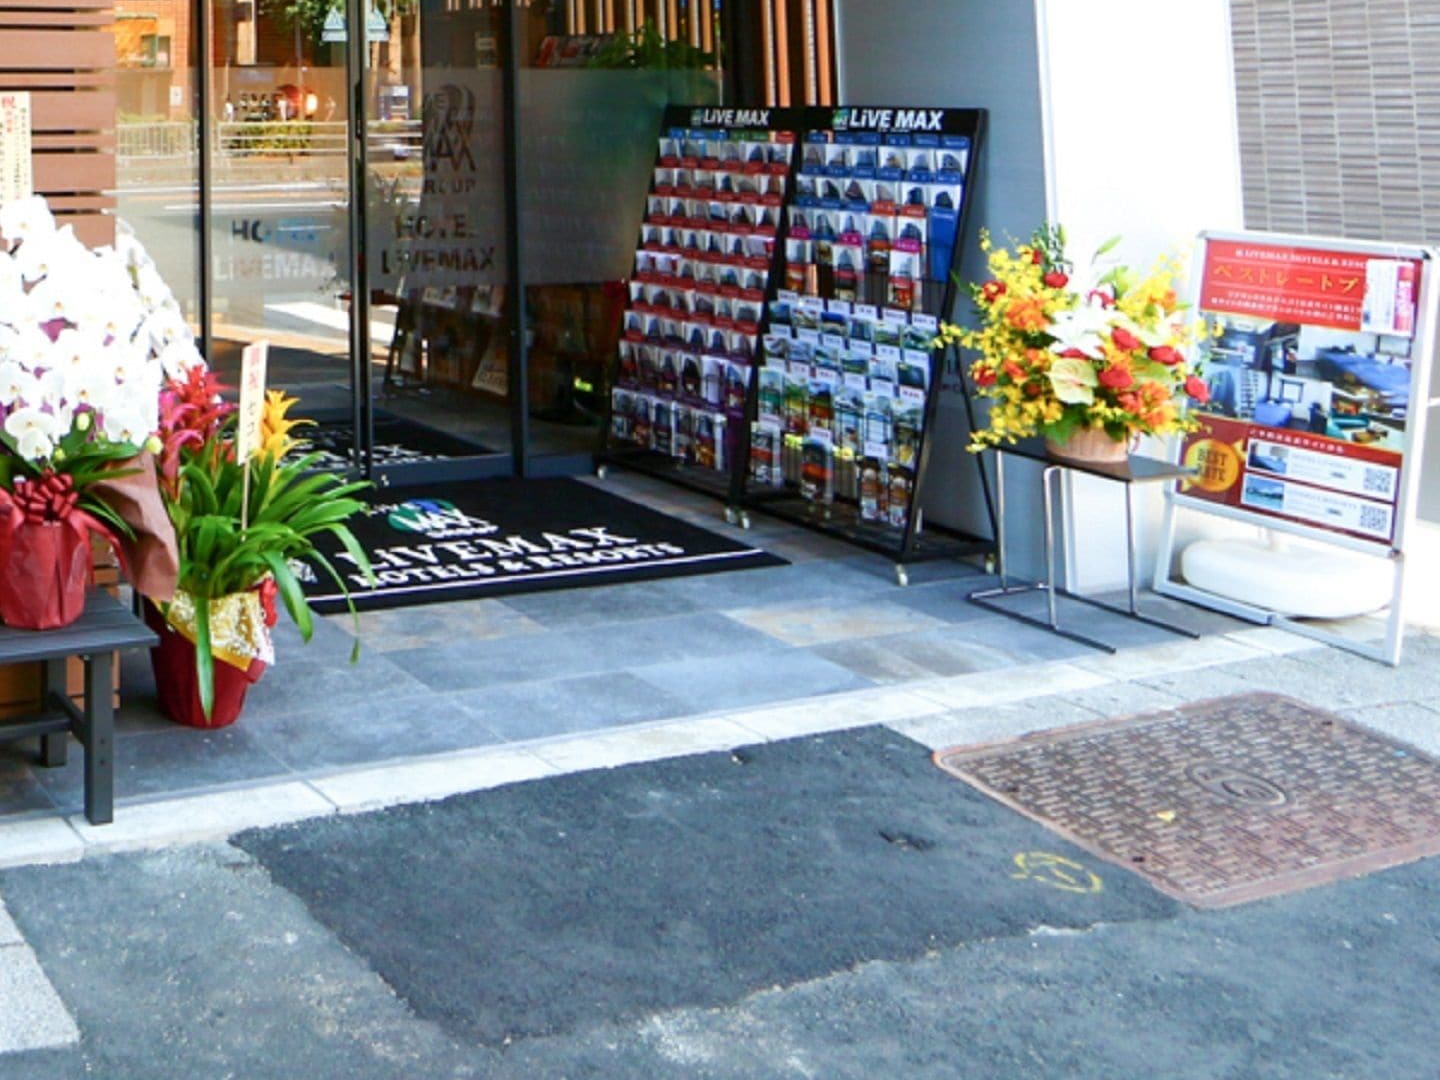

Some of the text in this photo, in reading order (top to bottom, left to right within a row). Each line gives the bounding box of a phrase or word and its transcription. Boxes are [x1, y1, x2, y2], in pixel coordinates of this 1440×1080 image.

[736, 109, 770, 126] MAX
[850, 108, 943, 131] LiVE MAX
[348, 542, 685, 588] HOTELS & RESORTS
